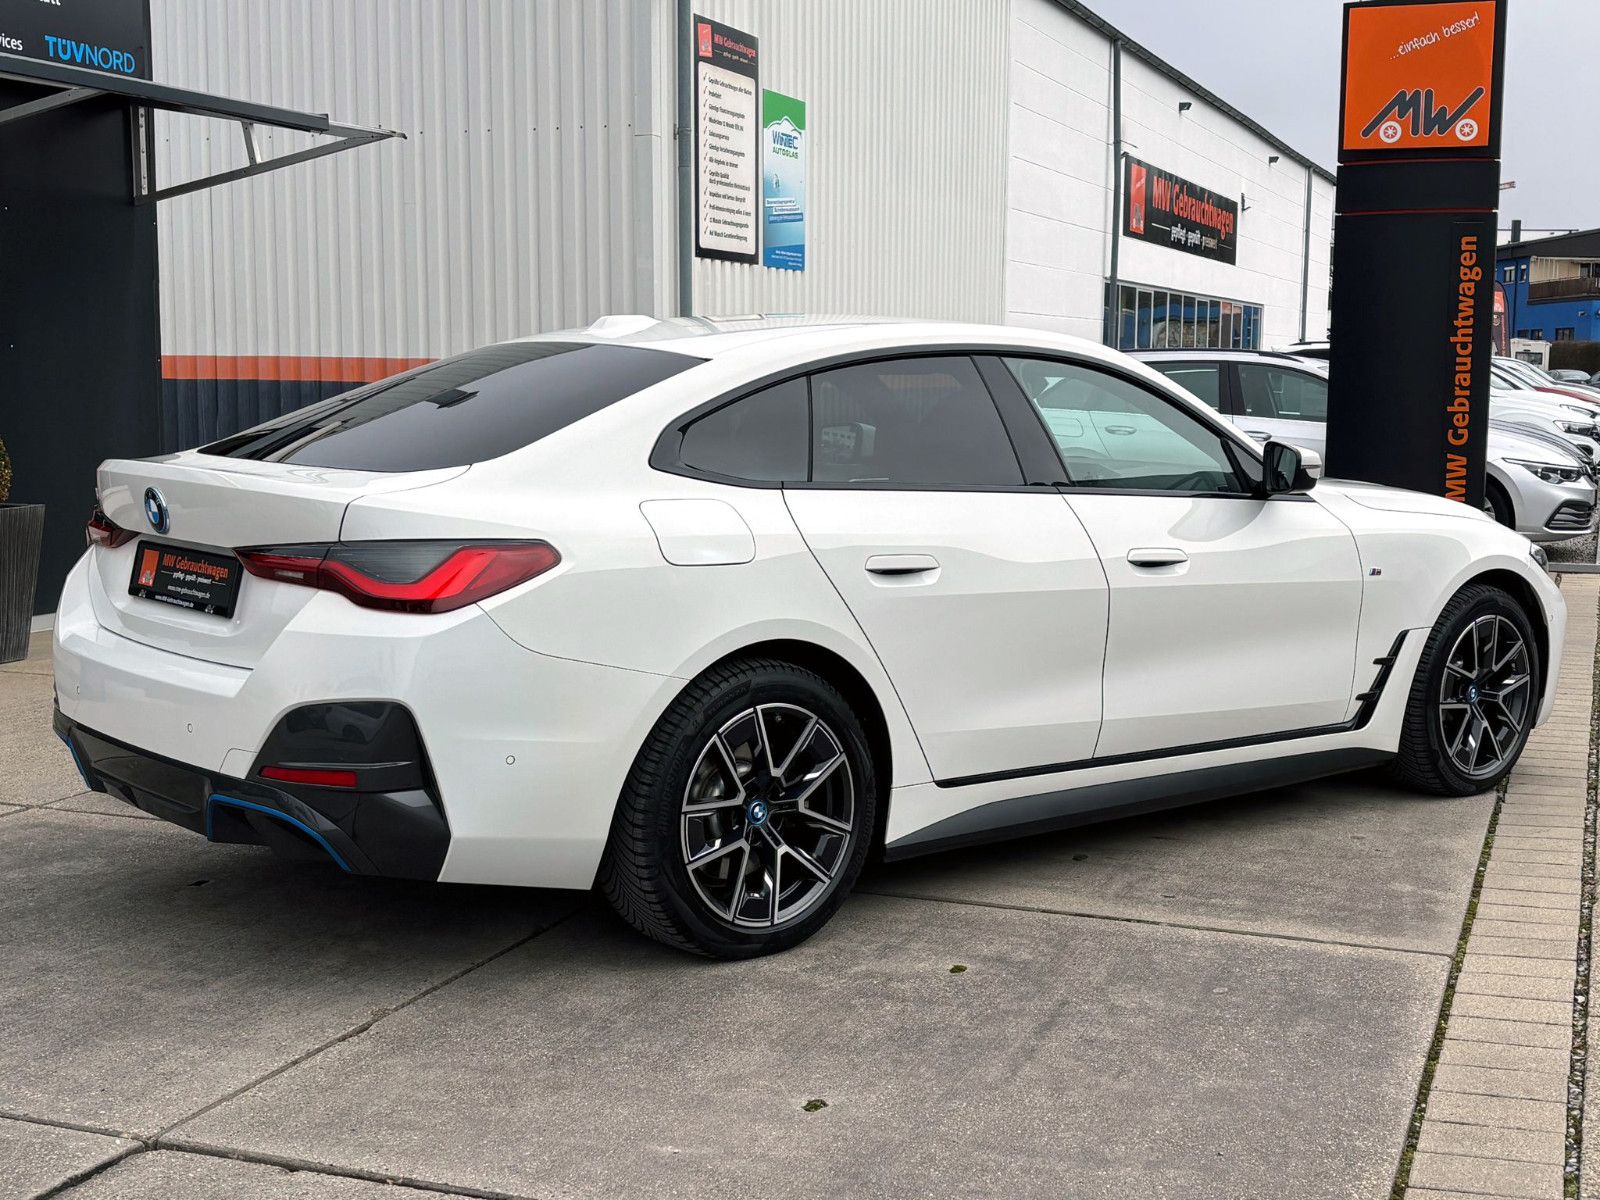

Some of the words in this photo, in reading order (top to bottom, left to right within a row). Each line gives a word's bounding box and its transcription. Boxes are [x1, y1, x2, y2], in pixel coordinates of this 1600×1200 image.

[1442, 11, 1480, 38] besser!
[1359, 86, 1486, 139] MW
[1152, 175, 1171, 213] MW
[1173, 183, 1234, 241] Gebrauchtwagen
[1447, 235, 1482, 446] Gebrauchtwagen
[1445, 453, 1467, 502] MW
[162, 553, 176, 567] MW
[176, 556, 229, 581] Gebrauchtwagen
